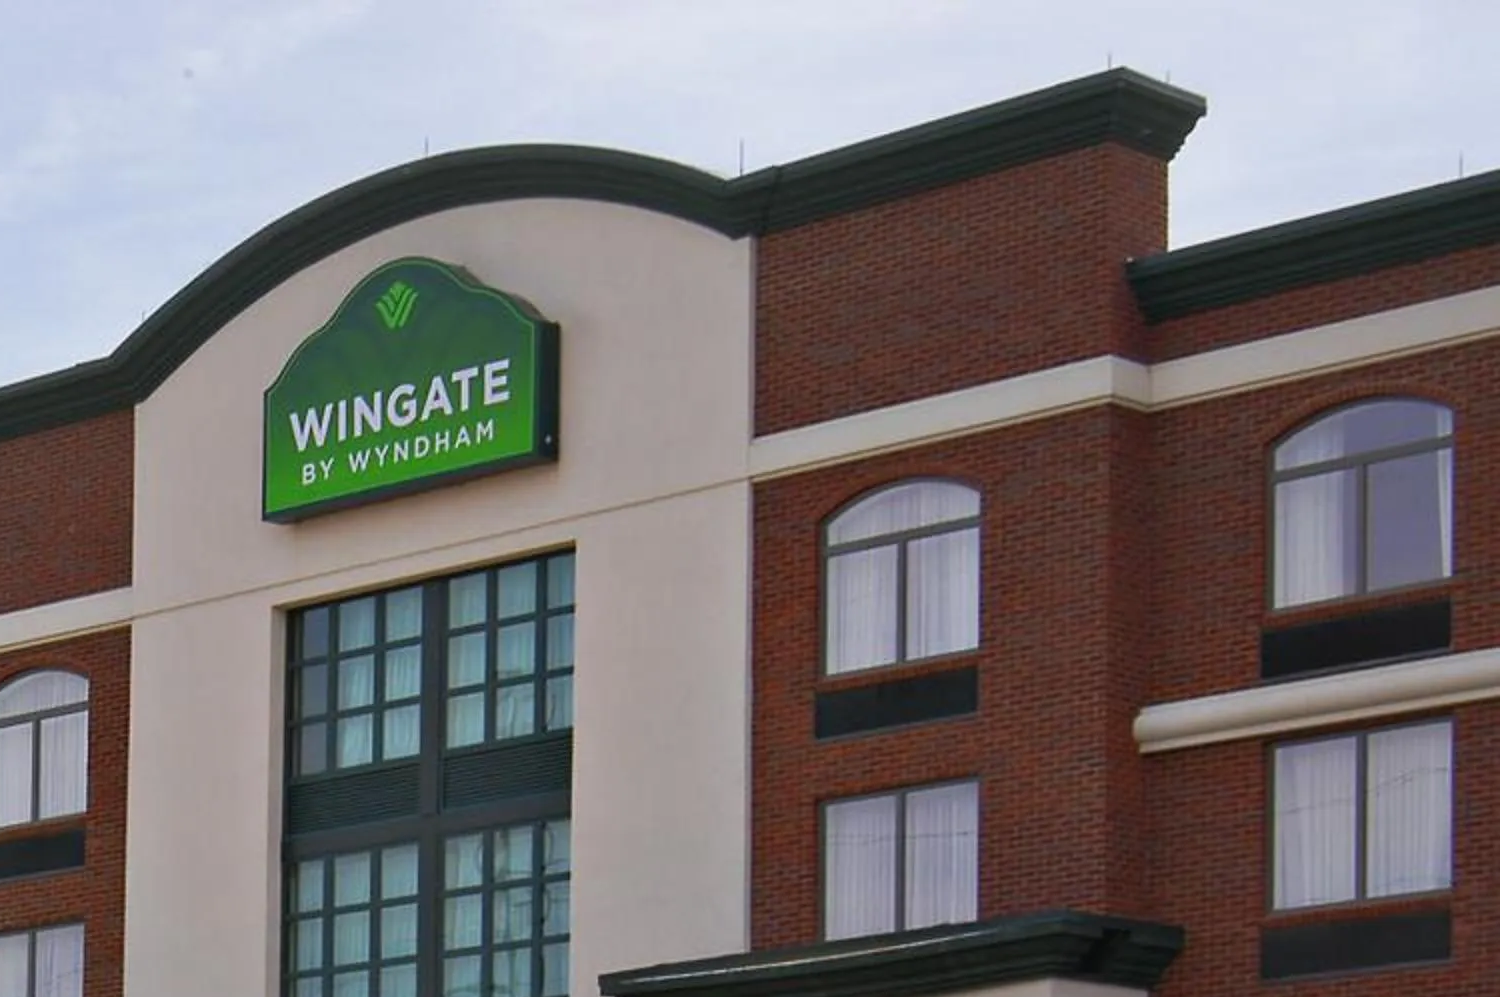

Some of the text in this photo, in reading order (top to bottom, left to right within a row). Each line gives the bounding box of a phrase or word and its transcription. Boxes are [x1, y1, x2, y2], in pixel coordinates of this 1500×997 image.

[289, 358, 511, 453] WINGATE
[302, 418, 495, 486] BY WYNDHAM
